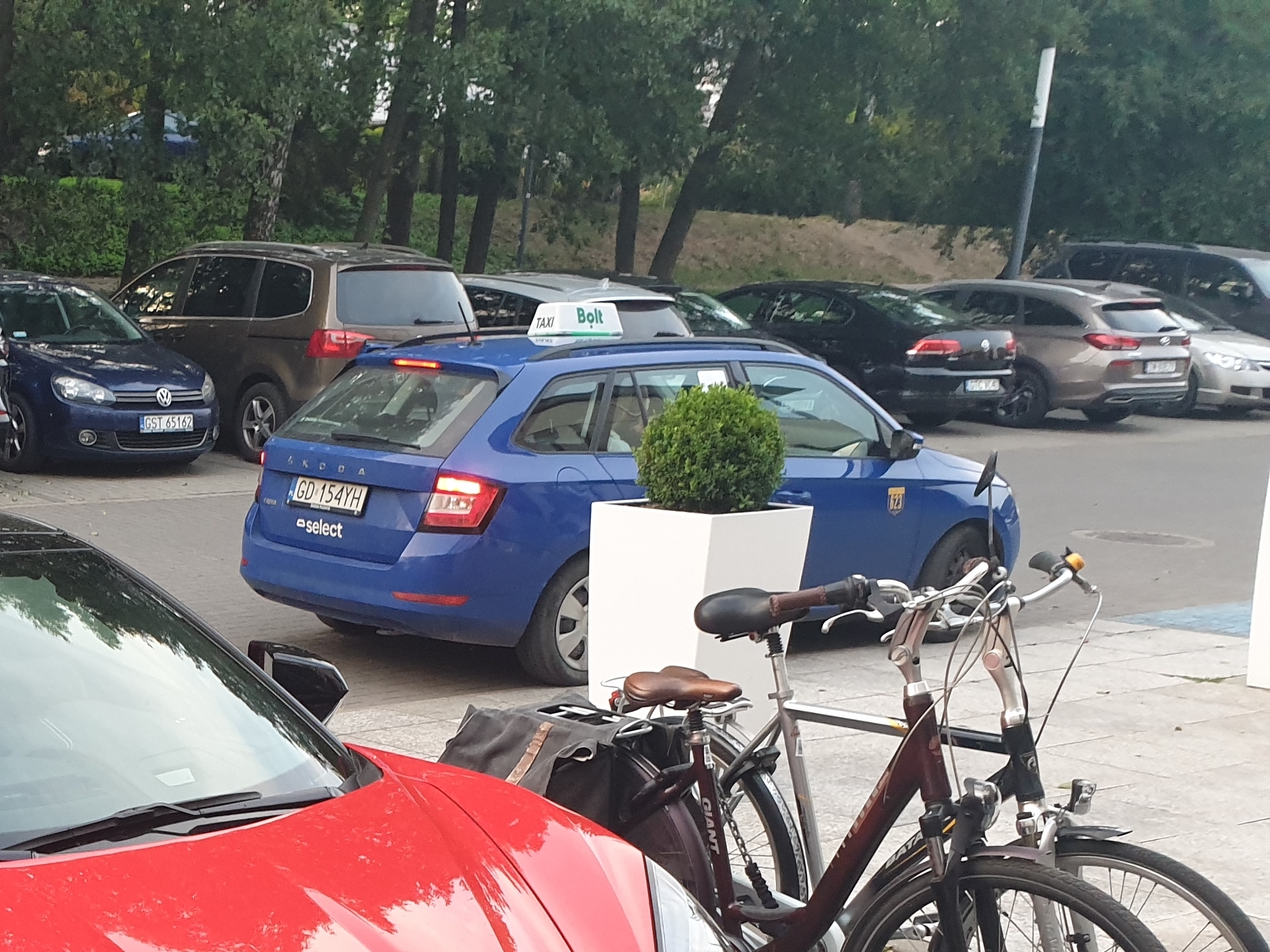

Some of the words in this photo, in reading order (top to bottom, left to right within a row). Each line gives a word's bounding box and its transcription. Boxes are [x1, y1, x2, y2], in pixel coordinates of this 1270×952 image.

[536, 316, 555, 329] TAXI
[576, 307, 604, 329] Bolt
[145, 417, 163, 430] GST
[165, 415, 193, 429] 65162
[296, 480, 316, 501] GD
[318, 483, 363, 509] 154YH
[305, 518, 343, 538] select
[701, 797, 721, 855] GIANT
